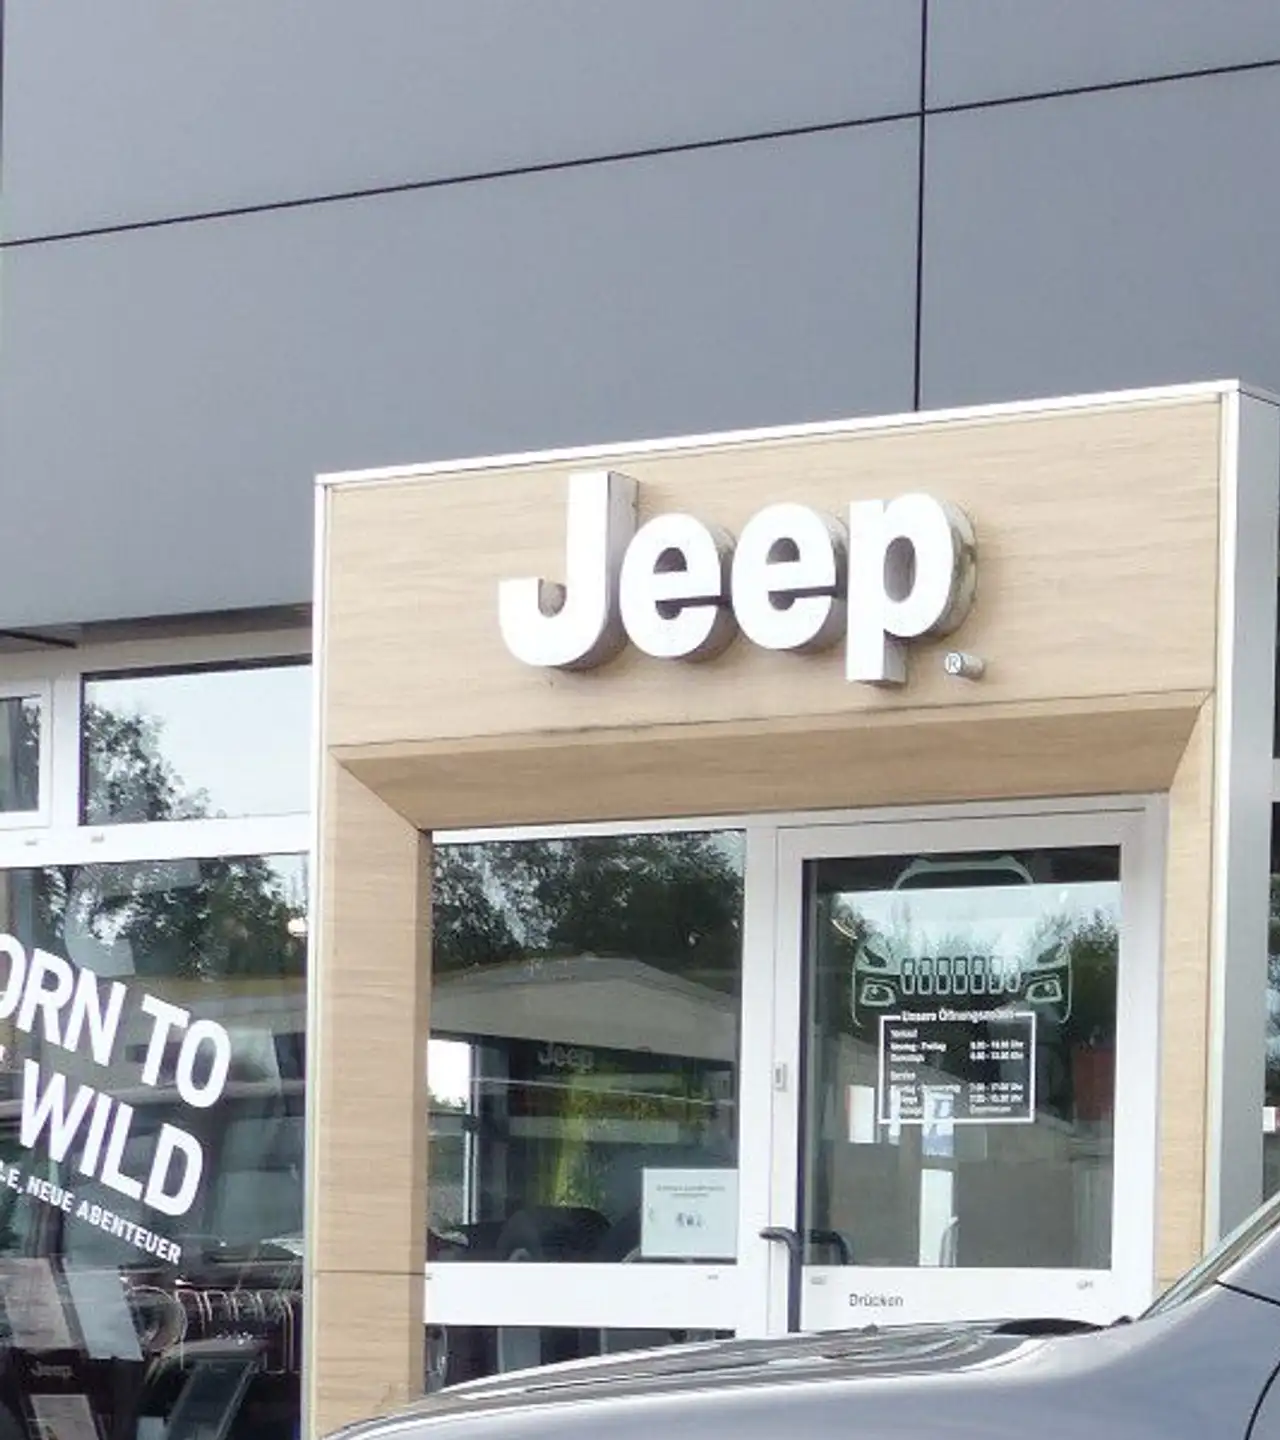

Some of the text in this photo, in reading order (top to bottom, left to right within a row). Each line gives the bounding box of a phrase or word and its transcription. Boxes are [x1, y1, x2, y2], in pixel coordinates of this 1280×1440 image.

[499, 470, 962, 684] Jeep
[140, 994, 232, 1109] TO
[19, 1058, 204, 1216] WILD
[26, 1175, 76, 1213] NEUE
[76, 1200, 182, 1265] ABENTEUER
